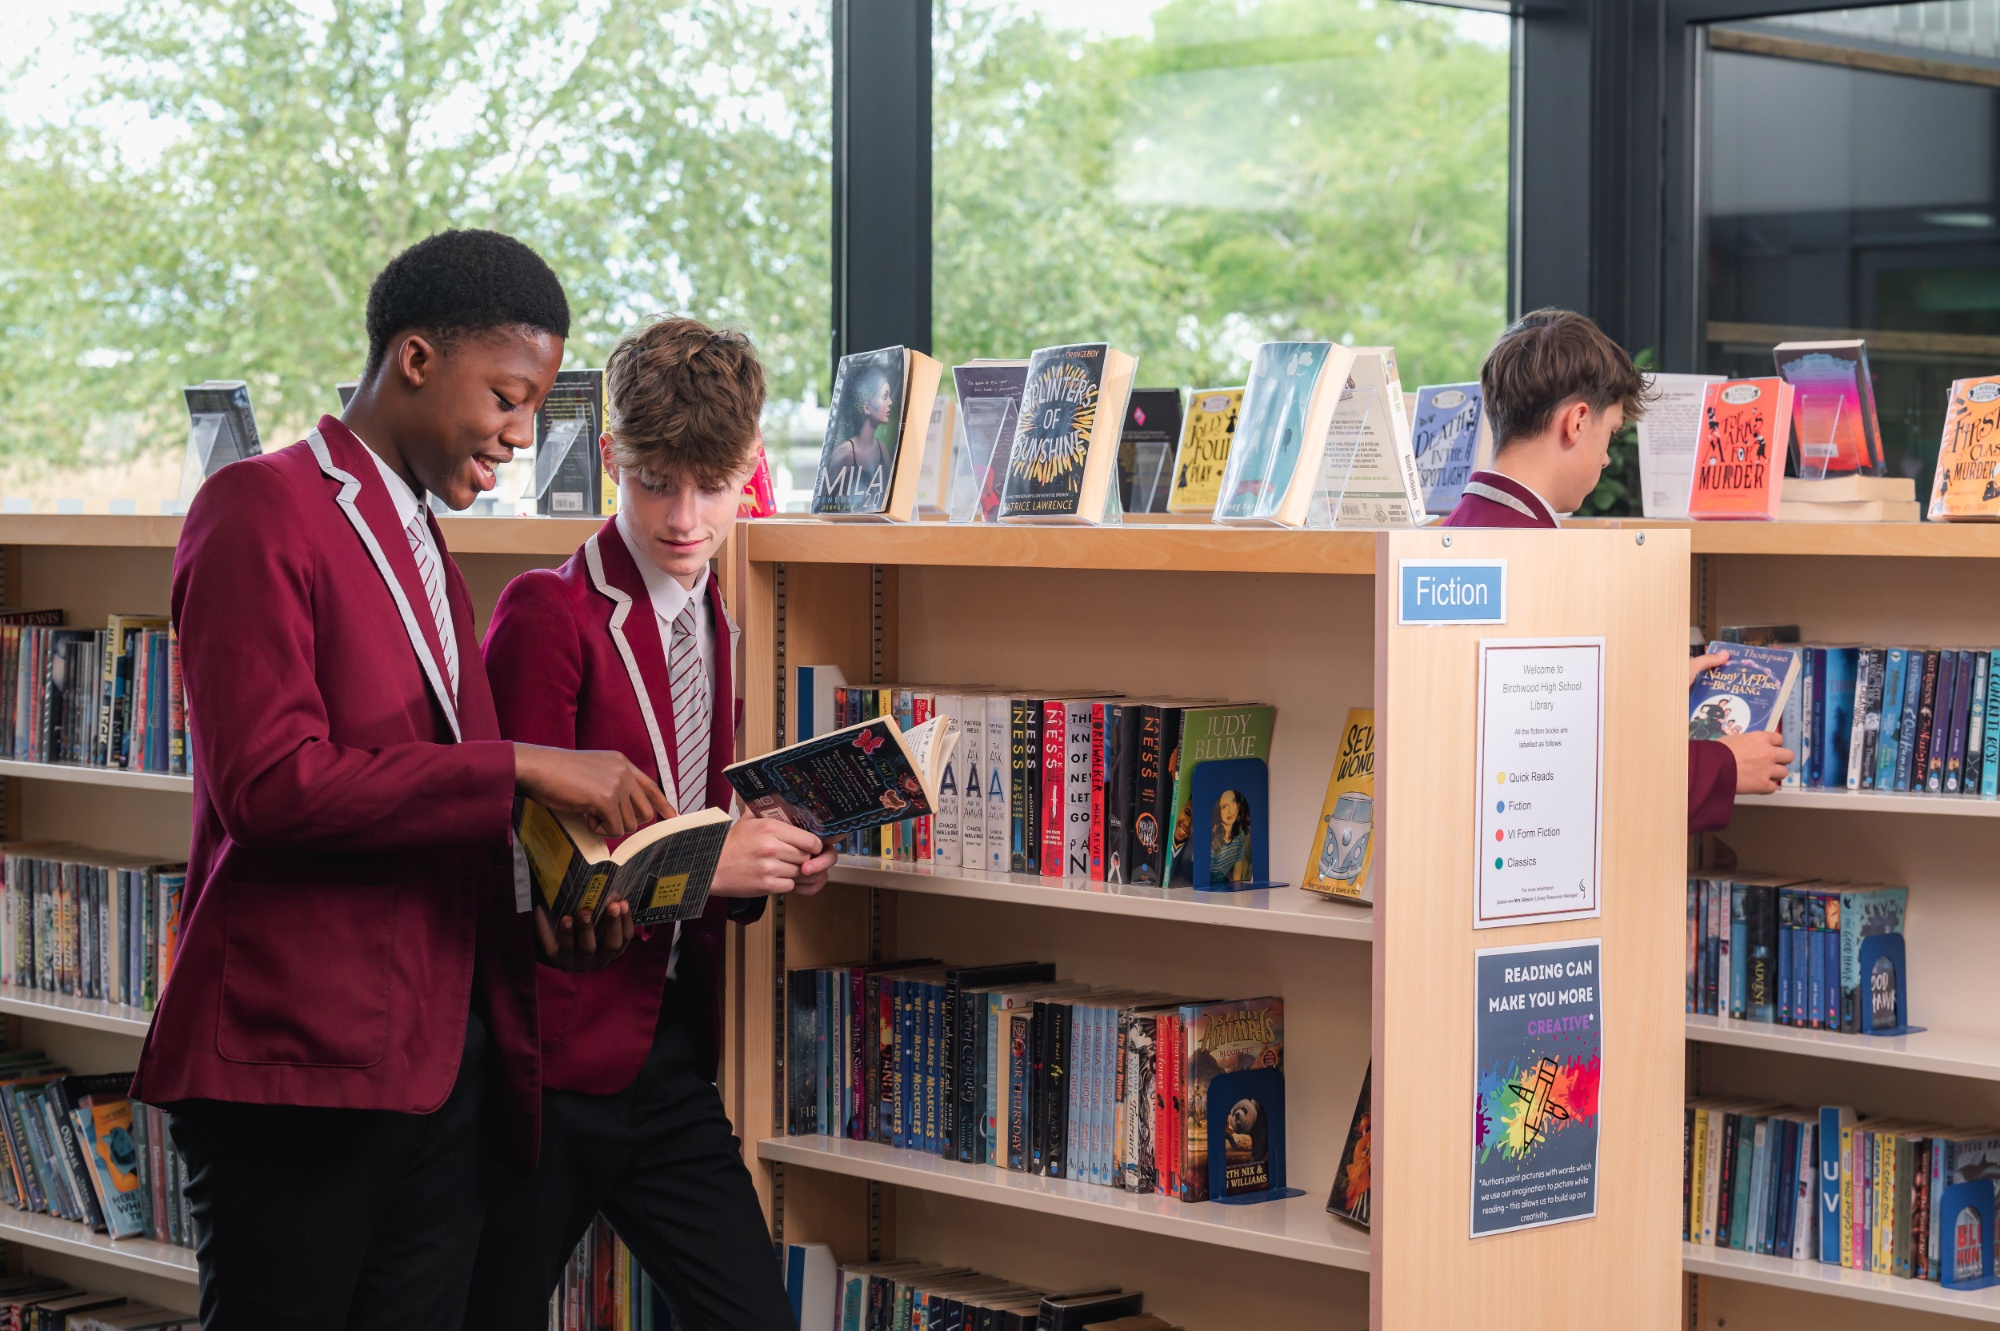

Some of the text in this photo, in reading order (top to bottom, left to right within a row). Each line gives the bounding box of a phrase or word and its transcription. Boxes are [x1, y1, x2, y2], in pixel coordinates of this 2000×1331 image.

[1022, 376, 1098, 413] SPLINTERS
[1043, 408, 1061, 430] OF
[1721, 410, 1744, 434] TOP
[1012, 429, 1085, 463] SUNSHINE
[1415, 411, 1465, 459] DEATH
[1431, 450, 1442, 465] IN
[1190, 464, 1212, 483] PLAY
[1420, 466, 1470, 488] SPOTLIGHT
[1699, 464, 1765, 490] MURDER
[1953, 461, 1996, 481] MURDER
[818, 464, 883, 508] MILA 2.0
[1032, 500, 1073, 511] LAWRENCE
[1416, 576, 1488, 606] Fiction
[21, 612, 60, 625] LEWIS
[106, 627, 115, 648] MAL
[1744, 648, 1788, 663] Thompson
[1523, 664, 1564, 675] Welcome to
[1702, 667, 1778, 690] Nanny McPhee
[1502, 681, 1582, 694] Birchwood High School
[1710, 680, 1761, 696] BIG BANG
[1530, 700, 1555, 712] Library
[99, 705, 109, 744] BECK
[1205, 713, 1252, 738] JUDY
[1530, 727, 1544, 735] fiction
[1903, 718, 1915, 739] Only
[1985, 673, 2000, 766] CONCRETE ROSE
[1013, 710, 1024, 770] NESS
[1026, 710, 1036, 769] NESS
[1046, 709, 1058, 769] NESS
[1092, 707, 1103, 792] STORMWALKER
[1141, 716, 1154, 778] NESS
[1152, 718, 1160, 779] PATRICK
[1194, 735, 1256, 761] BLUME
[878, 761, 891, 777] Yes!
[1071, 753, 1088, 763] OF
[1898, 740, 1913, 778] Human
[966, 763, 982, 799] A
[988, 767, 1005, 803] A
[1509, 771, 1554, 783] Quick Reads
[1070, 813, 1090, 822] GO
[1508, 801, 1532, 811] Fiction
[1507, 827, 1561, 839] VI Form Fiction
[1507, 857, 1537, 868] Classics
[588, 877, 603, 893] MORE
[645, 912, 674, 921] NESS
[1504, 960, 1593, 983] READING CAN
[1752, 960, 1765, 1007] ADVENT
[894, 996, 901, 1010] WE
[1489, 987, 1594, 1013] MAKE YOU MORE
[1218, 1010, 1259, 1025] SPIRIT
[1198, 1008, 1276, 1053] ANIMALS
[912, 997, 921, 1135] WE MADE MOLECULES
[926, 1000, 935, 1139] WE MADE MOLECULES
[1070, 1019, 1079, 1108] JESSICA'S GHOST
[1157, 1057, 1166, 1090] forest
[1173, 1059, 1181, 1091] forest
[893, 1072, 901, 1134] MOLECULES
[1082, 1076, 1090, 1110] GHOST
[1094, 1077, 1102, 1112] GHOST
[1012, 1058, 1023, 1152] SIR THURSDAY
[1957, 1140, 1982, 1154] STEVE
[1230, 1173, 1268, 1188] WILLIAMS
[1241, 1164, 1263, 1177] NIX &
[1505, 1174, 1521, 1186] paint
[1521, 1171, 1545, 1182] pictures
[1545, 1167, 1558, 1177] with
[1558, 1164, 1576, 1175] words
[1576, 1162, 1592, 1172] which
[1823, 1160, 1839, 1181] U
[1501, 1189, 1511, 1198] our
[1511, 1184, 1546, 1197] imagination
[1547, 1182, 1554, 1190] to
[1554, 1179, 1574, 1191] picture
[1574, 1176, 1589, 1185] while
[1482, 1191, 1587, 1215] reading this allows us to build up our
[1823, 1192, 1839, 1213] V
[1520, 1211, 1549, 1223] creativity.
